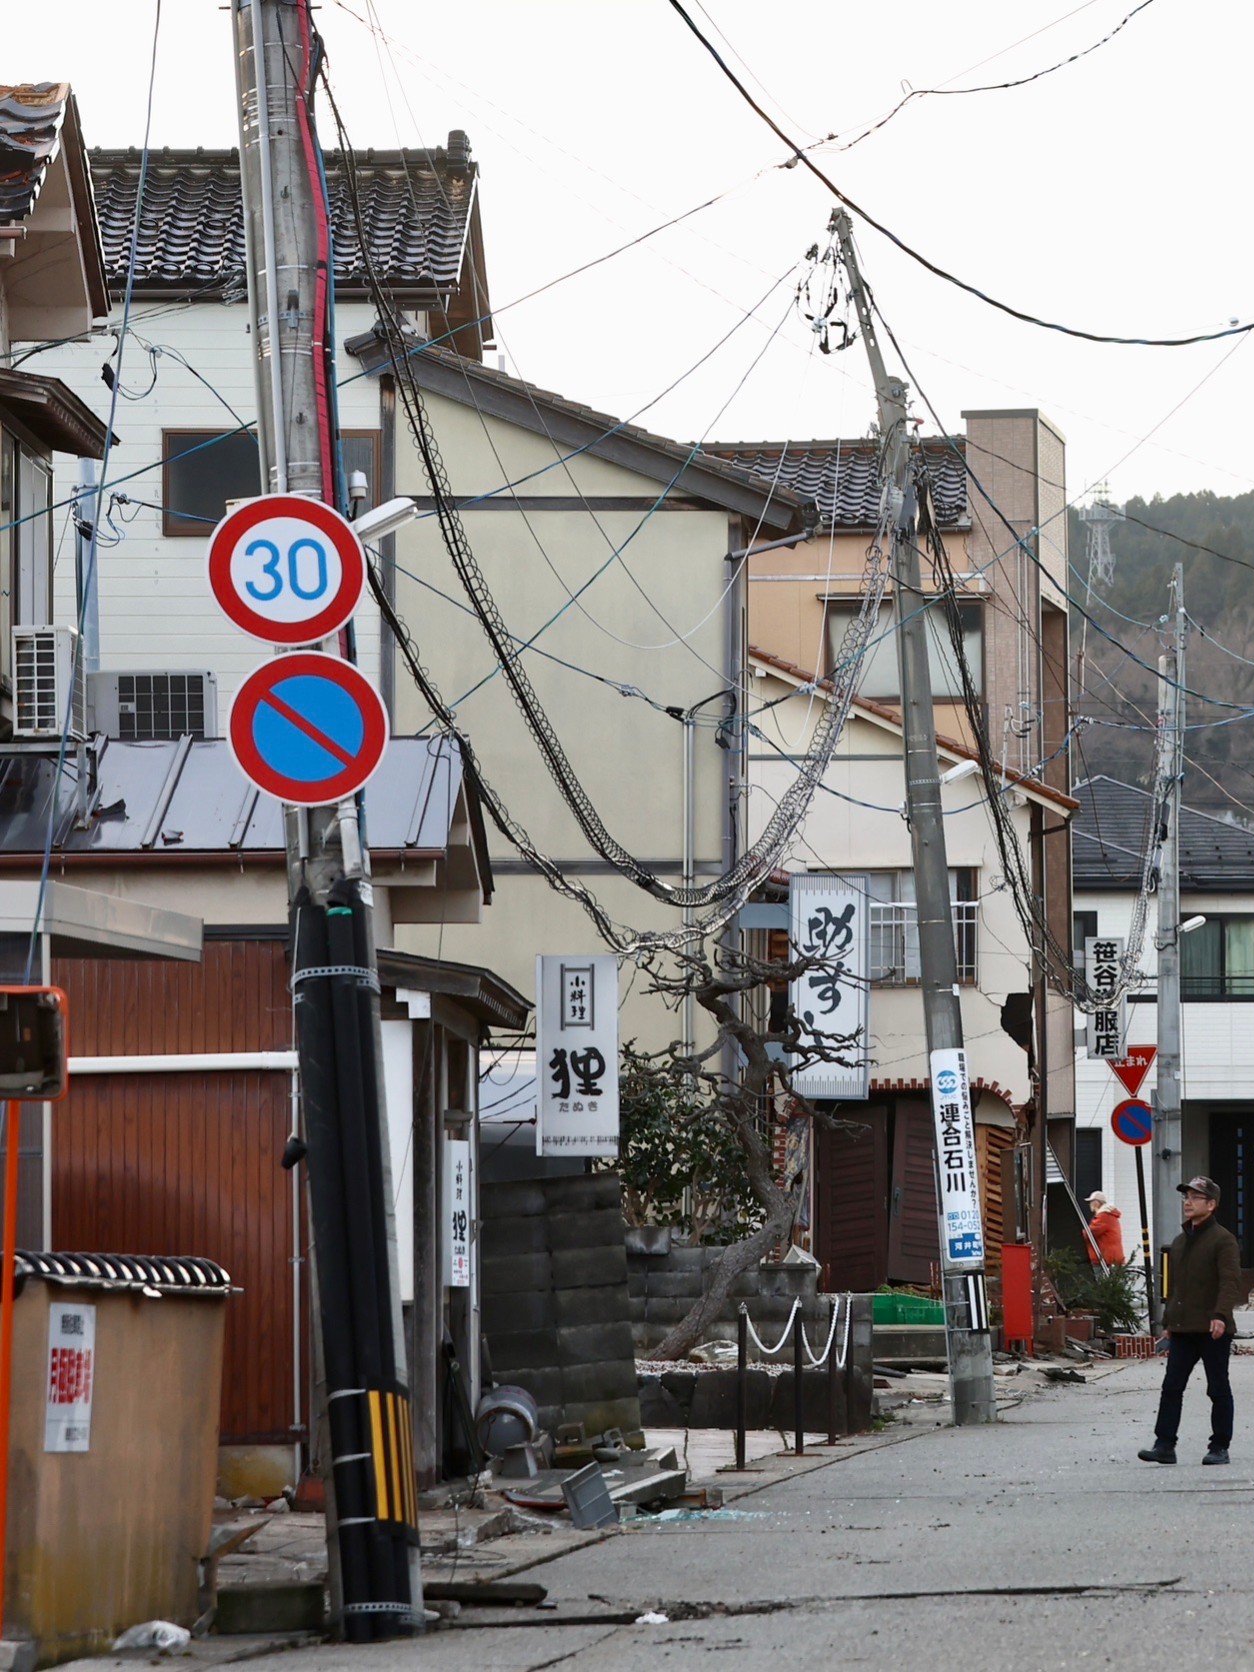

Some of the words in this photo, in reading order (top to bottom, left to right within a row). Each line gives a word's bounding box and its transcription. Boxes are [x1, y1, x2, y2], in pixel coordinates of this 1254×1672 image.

[244, 537, 328, 602] 30
[569, 975, 586, 1020] 小料理
[1092, 941, 1119, 1056] 笹谷服店
[549, 1047, 606, 1100] 狸
[558, 1101, 599, 1113] たぬき
[939, 1102, 966, 1194] 連合石川
